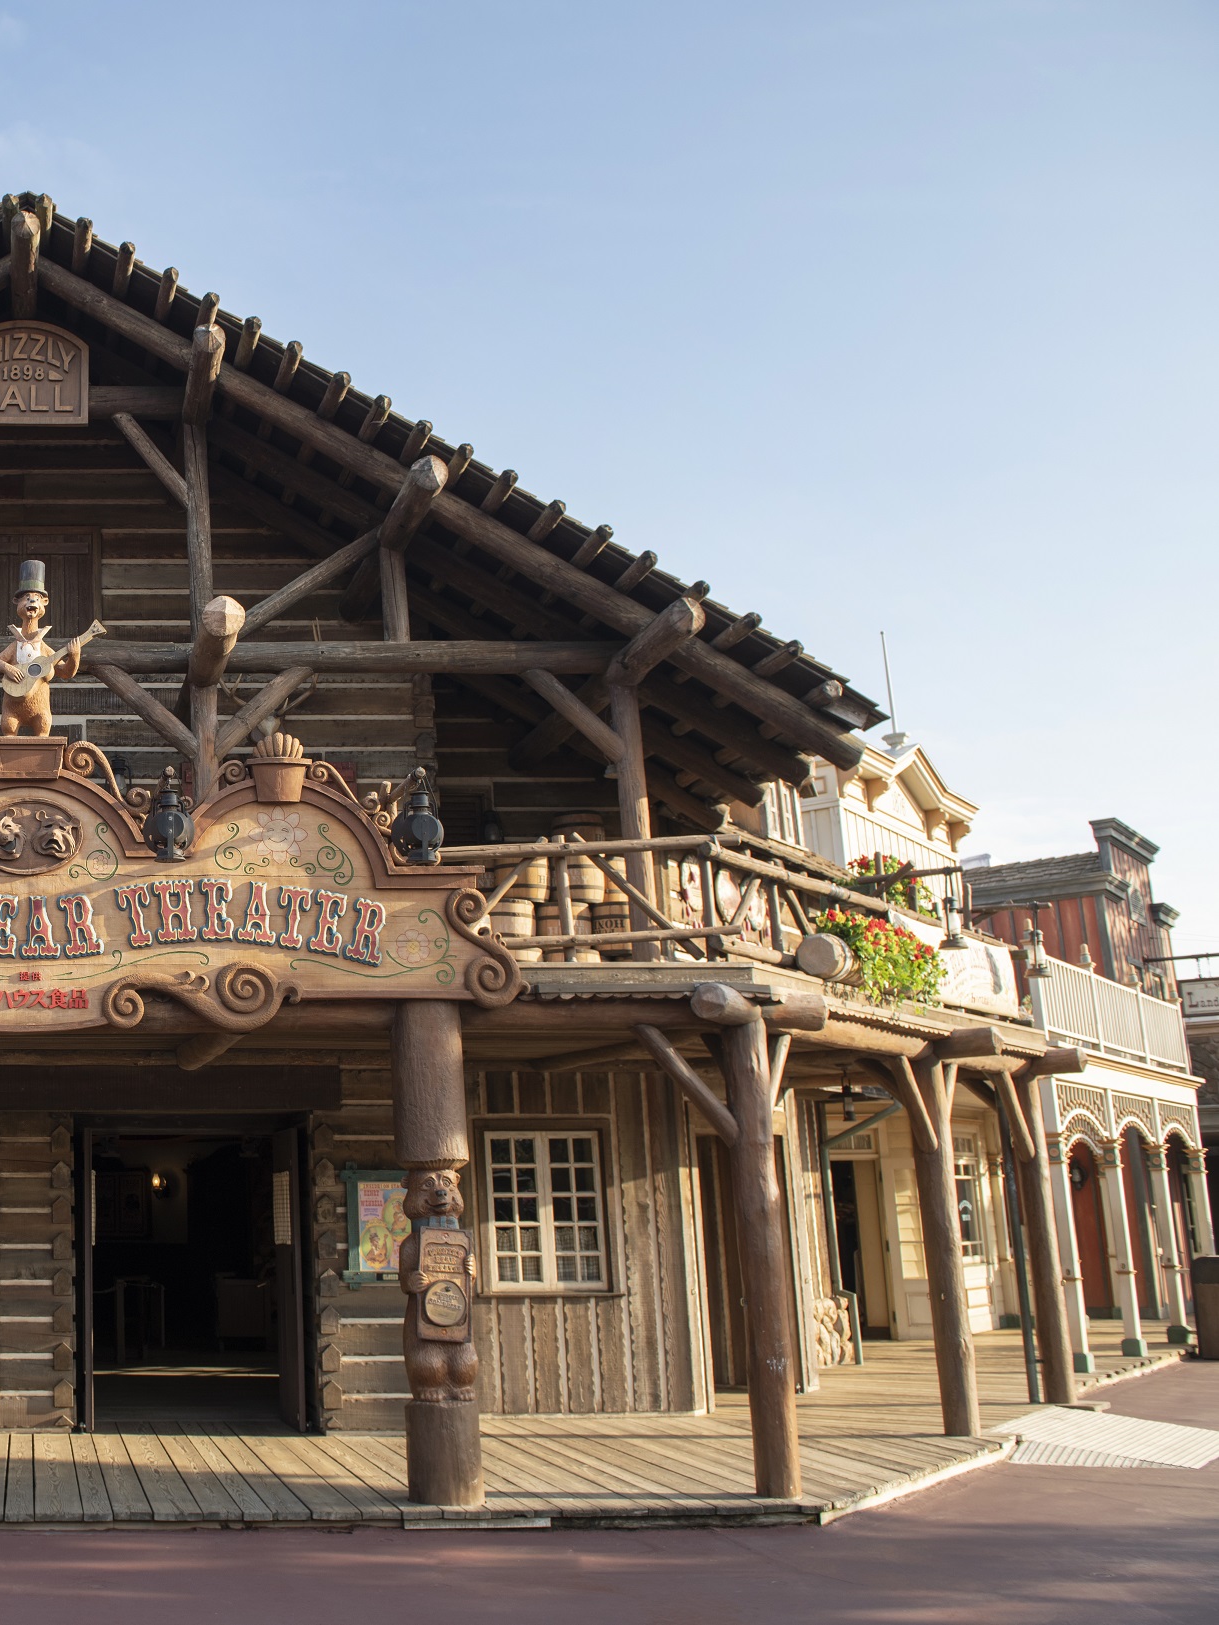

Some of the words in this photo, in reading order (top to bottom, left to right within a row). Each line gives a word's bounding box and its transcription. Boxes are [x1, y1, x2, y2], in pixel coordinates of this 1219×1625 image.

[2, 364, 45, 381] 1898
[114, 878, 386, 967] THEATER
[19, 971, 42, 981] 提供
